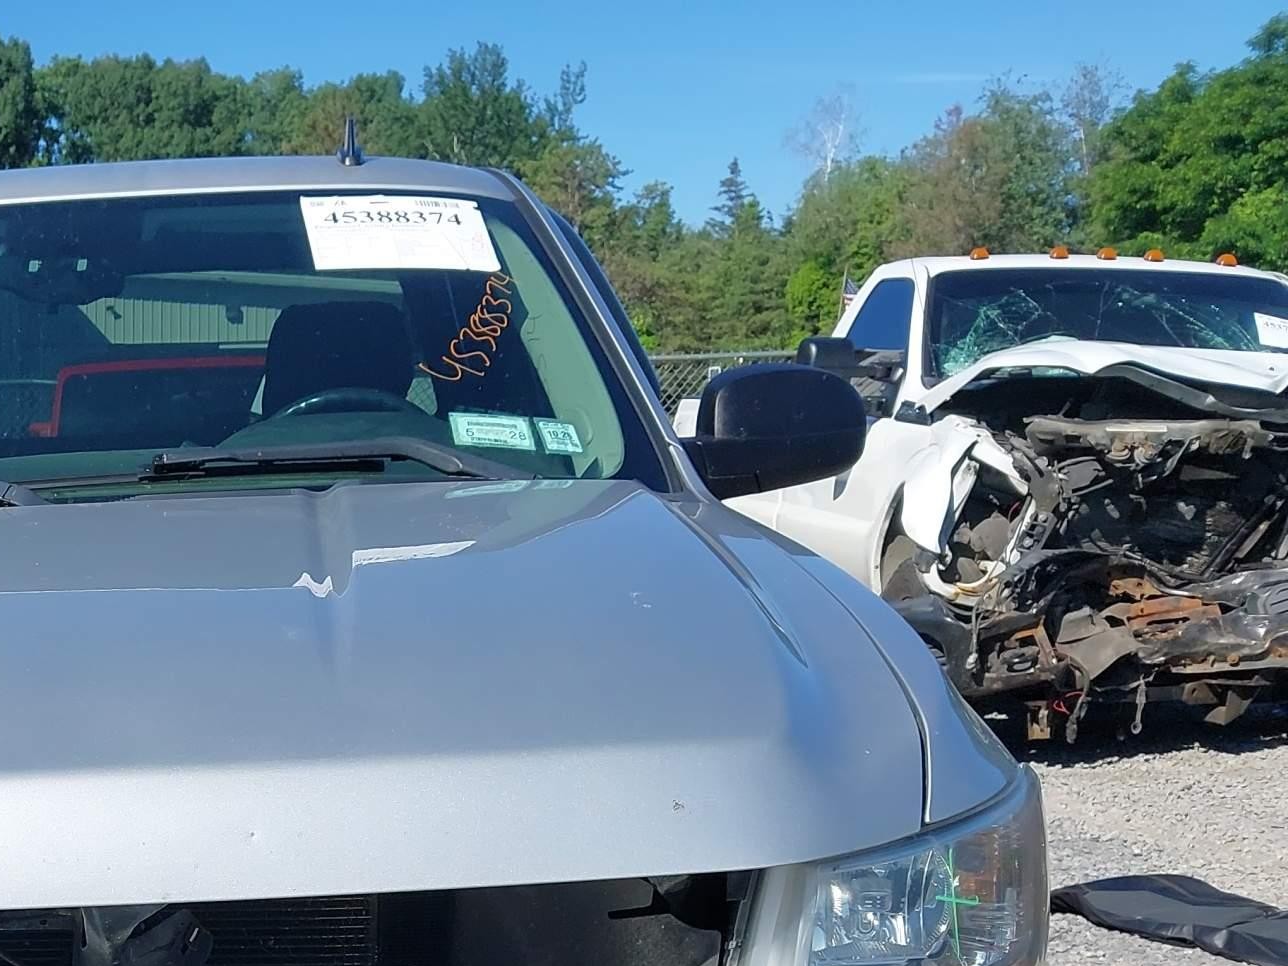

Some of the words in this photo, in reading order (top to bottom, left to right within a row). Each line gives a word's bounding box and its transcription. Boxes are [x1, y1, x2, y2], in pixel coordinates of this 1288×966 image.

[323, 210, 463, 226] 45388374
[418, 270, 513, 381] 45388374
[508, 430, 527, 441] 28
